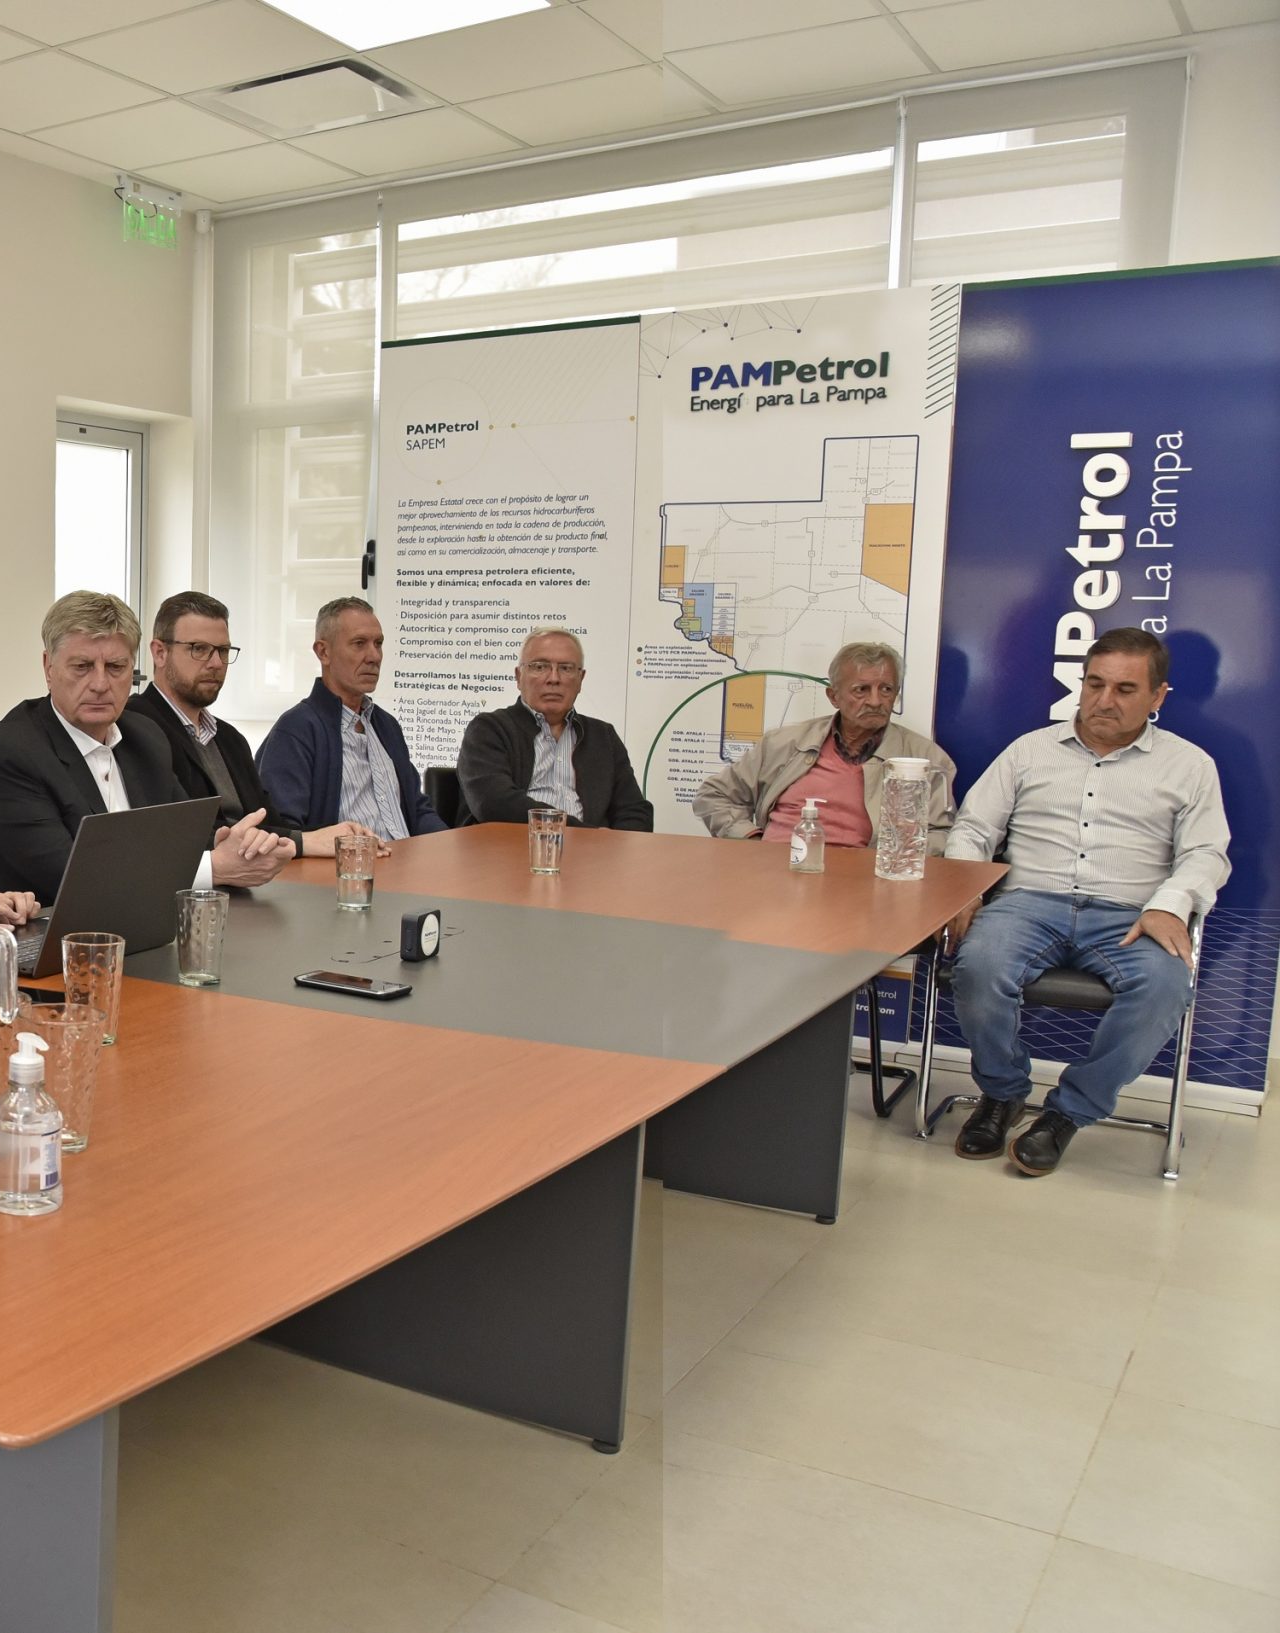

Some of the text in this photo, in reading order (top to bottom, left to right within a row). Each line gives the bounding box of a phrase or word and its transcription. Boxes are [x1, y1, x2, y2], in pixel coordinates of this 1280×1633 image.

[691, 352, 889, 391] PAMPetrol
[756, 393, 794, 412] para
[800, 388, 820, 404] La
[826, 386, 887, 405] Pampa
[406, 420, 479, 435] PAMPetrol
[406, 437, 446, 450] SAPEM
[1136, 430, 1192, 548] Pampa
[398, 499, 407, 507] La
[408, 498, 438, 508] Empresa
[440, 497, 464, 506] Estatal
[485, 497, 498, 505] con
[500, 496, 507, 504] el
[544, 494, 553, 502] de
[555, 494, 577, 504] lograr
[398, 512, 417, 521] mejor
[418, 511, 477, 520] aprovechamiento
[479, 509, 488, 517] de
[490, 508, 500, 517] los
[440, 522, 483, 531] interviniendo
[496, 520, 512, 529] toda
[514, 520, 521, 528] la
[523, 520, 550, 529] cadena
[551, 519, 561, 528] de
[397, 536, 417, 544] desde
[488, 534, 495, 542] la
[533, 532, 543, 541] de
[555, 532, 588, 542] producto
[591, 531, 608, 541] final,
[508, 546, 549, 555] almacenaje
[551, 547, 556, 555] y
[445, 569, 484, 578] empresa
[486, 568, 529, 577] petrolera
[531, 567, 575, 576] eficiente,
[1049, 432, 1133, 721] MPetrol
[396, 579, 427, 587] flexible
[430, 581, 435, 589] y
[437, 579, 479, 588] dinámica;
[481, 579, 522, 587] enfocada
[539, 579, 573, 587] valores
[576, 578, 590, 586] de:
[1131, 562, 1172, 600] La
[400, 598, 510, 609] Integridad y transparencia
[400, 611, 567, 622] Disposición para asumir distintos retos
[447, 627, 452, 635] y
[454, 626, 509, 636] compromiso
[400, 637, 453, 647] Compromiso
[474, 638, 481, 646] el
[484, 638, 501, 647] bien
[399, 650, 452, 659] Preservación
[454, 651, 468, 660] del
[470, 652, 497, 660] medio
[394, 670, 456, 680] Desarrollamos
[459, 672, 470, 680] las
[394, 681, 446, 691] Estratégicas
[461, 684, 504, 693] Negocios:
[417, 698, 460, 707] Gobernador
[461, 700, 480, 708] Ayala
[417, 716, 452, 725] Rinconada
